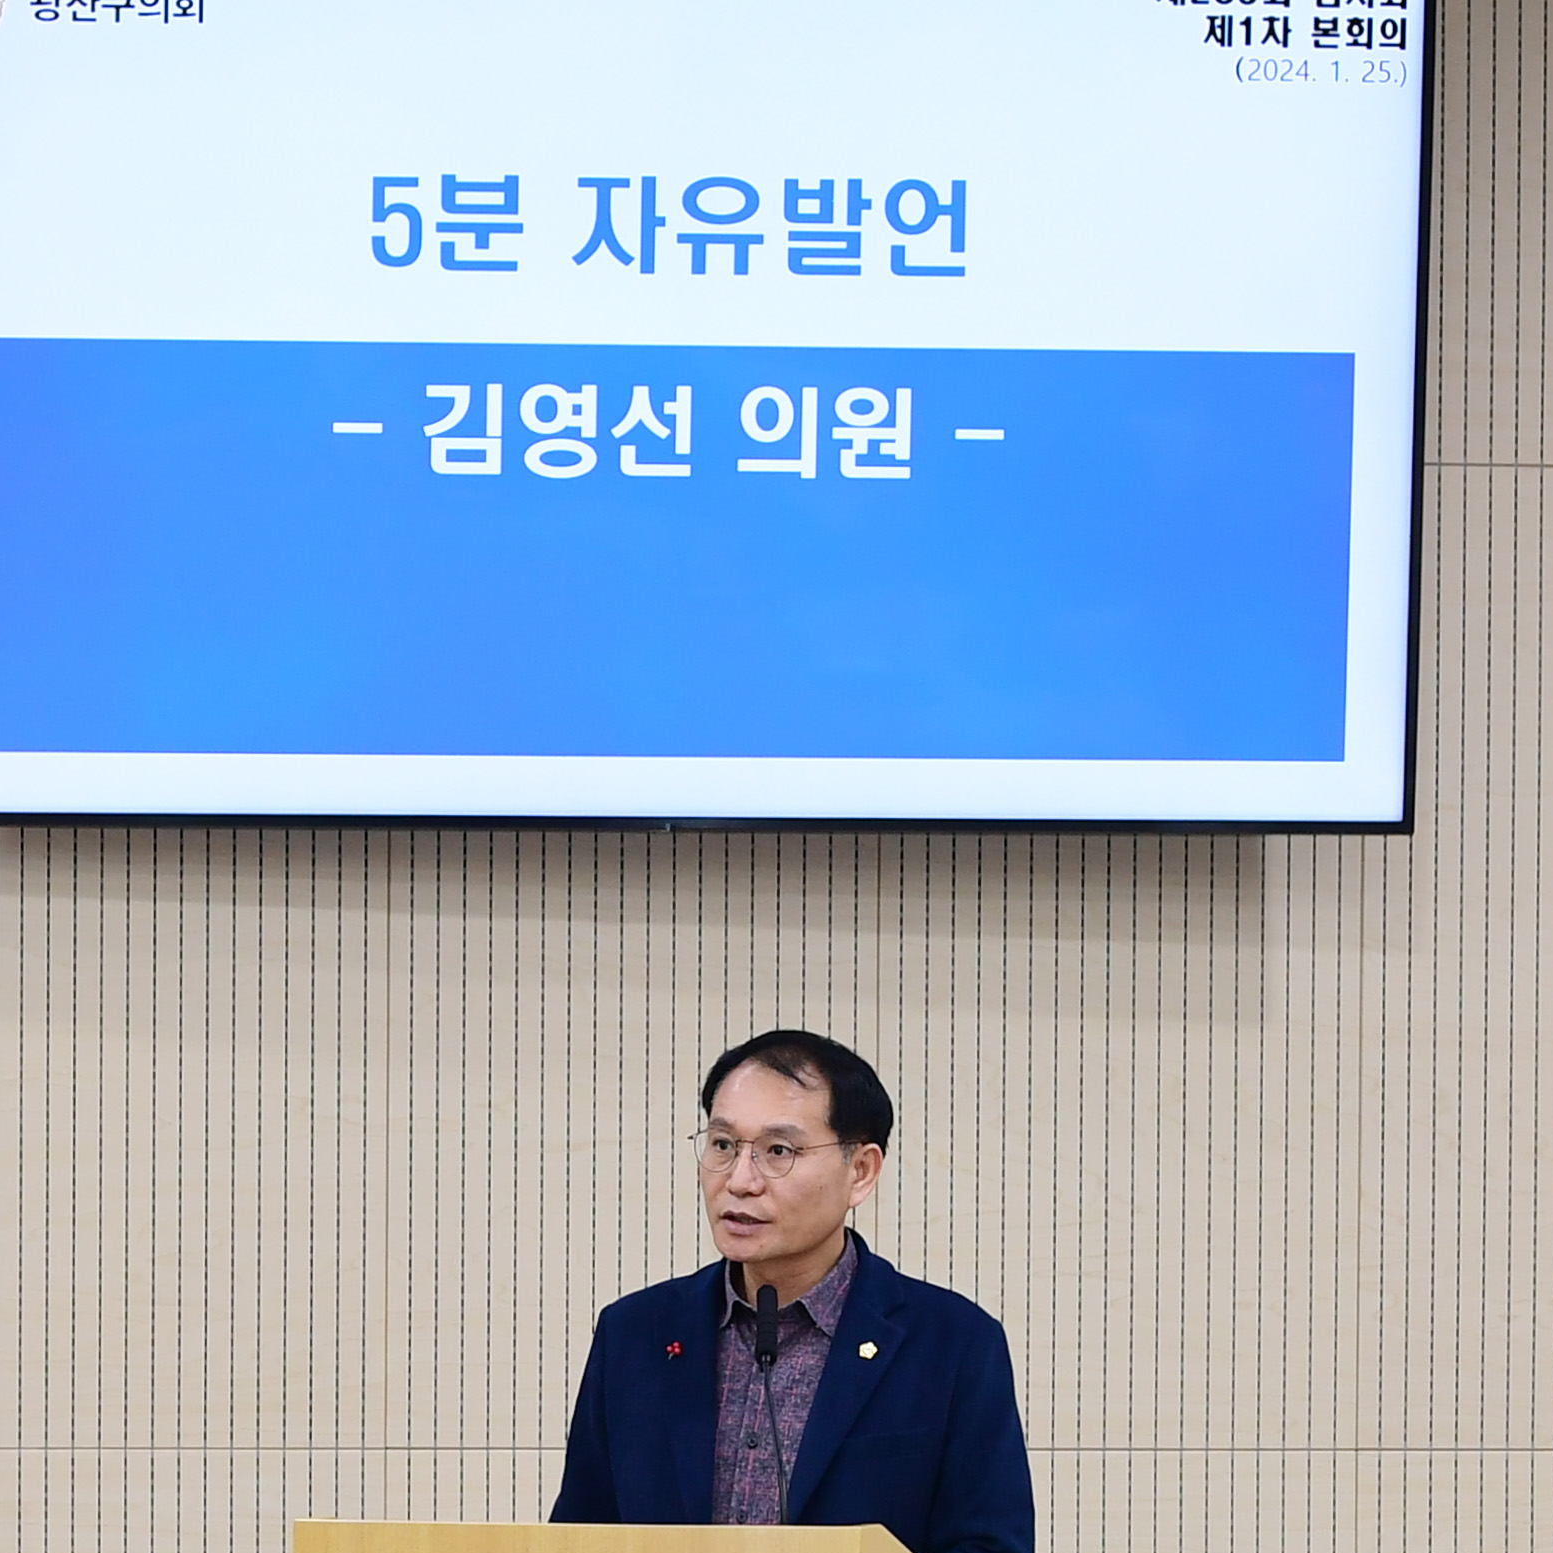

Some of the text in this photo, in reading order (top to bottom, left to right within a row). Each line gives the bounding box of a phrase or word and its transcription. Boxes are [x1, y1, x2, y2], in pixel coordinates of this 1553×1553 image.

[1203, 15, 1407, 51] 제1차 본회의
[1235, 56, 1407, 88] (2024. 1. 25.)
[371, 174, 967, 277] 5분 자유발언
[423, 383, 692, 479] 김영선
[737, 385, 913, 480] 의원
